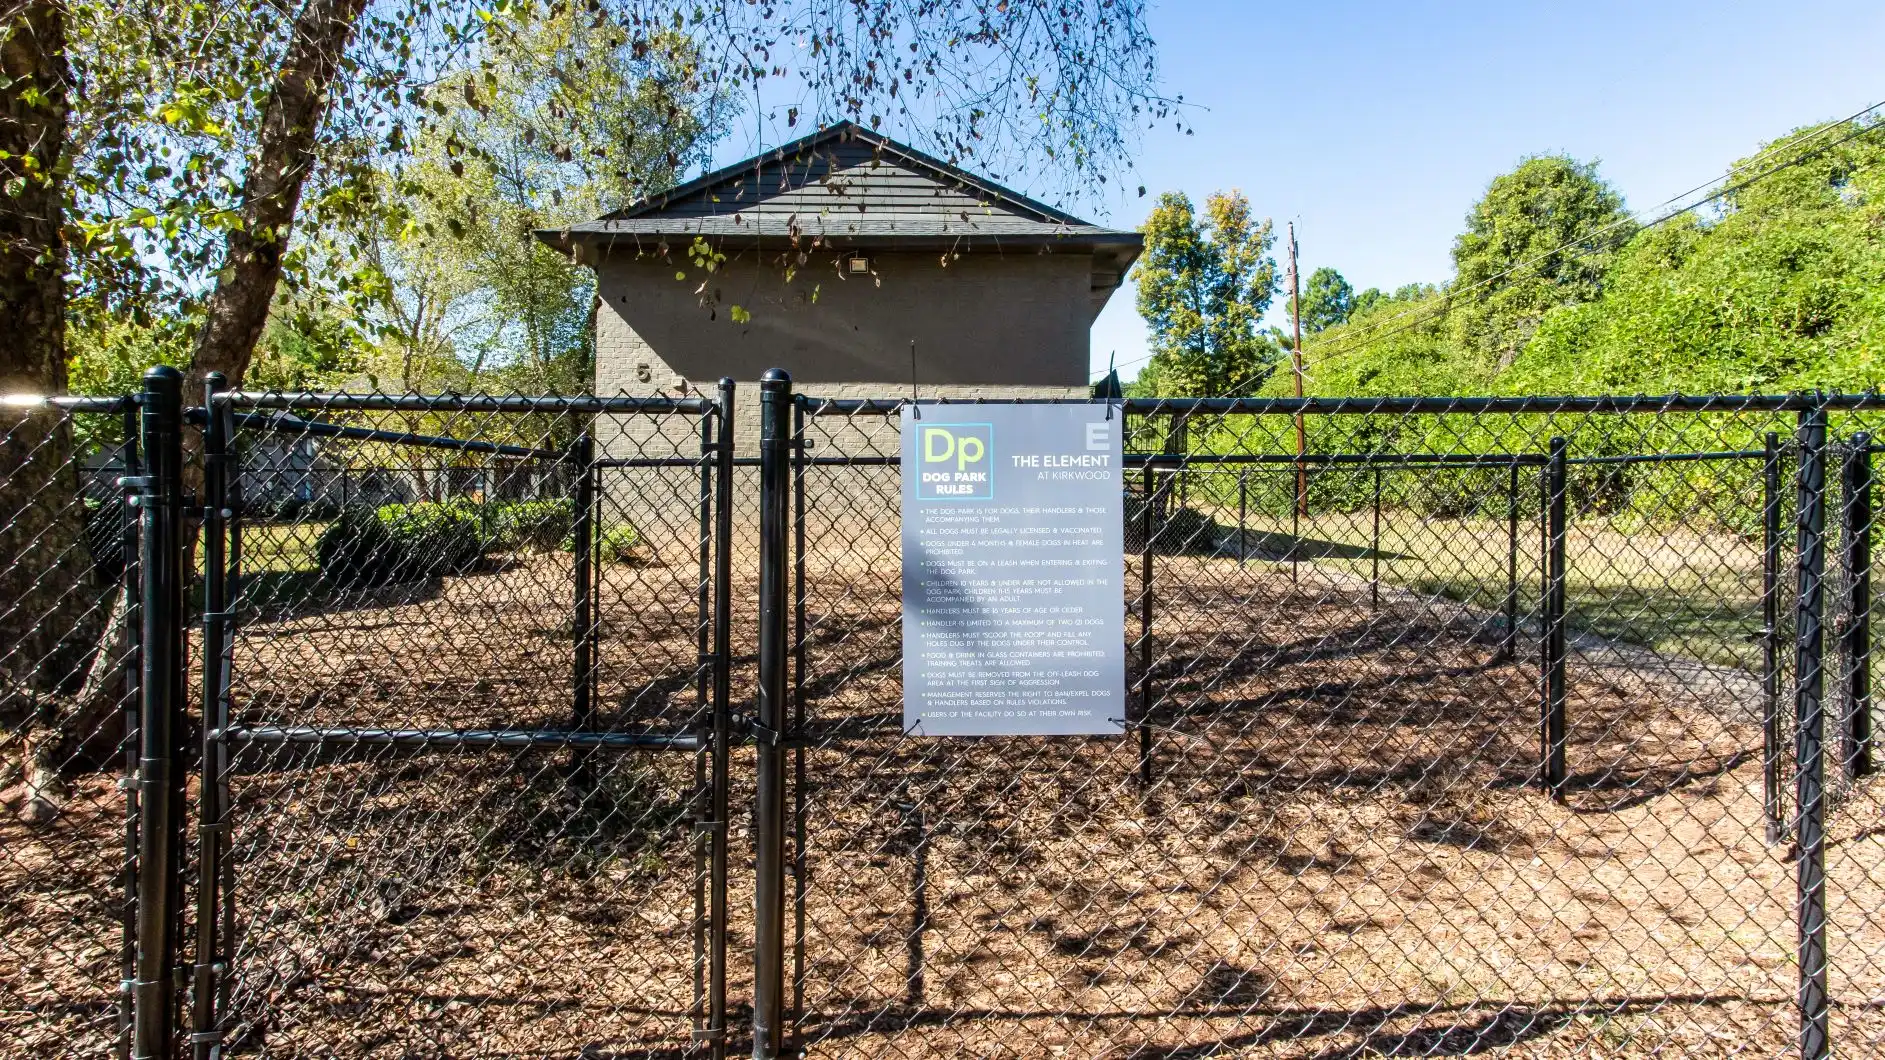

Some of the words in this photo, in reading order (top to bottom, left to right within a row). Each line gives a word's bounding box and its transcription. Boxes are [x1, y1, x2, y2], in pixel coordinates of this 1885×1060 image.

[637, 363, 650, 382] 5
[1086, 423, 1110, 450] E
[925, 428, 984, 471] Dp
[1012, 455, 1039, 468] THE
[1043, 455, 1110, 467] ELEMENT
[922, 473, 951, 482] DOG
[954, 473, 986, 482] PARK
[1037, 471, 1049, 480] AT
[1052, 471, 1110, 480] KIRKWOOD
[936, 485, 974, 494] RULES
